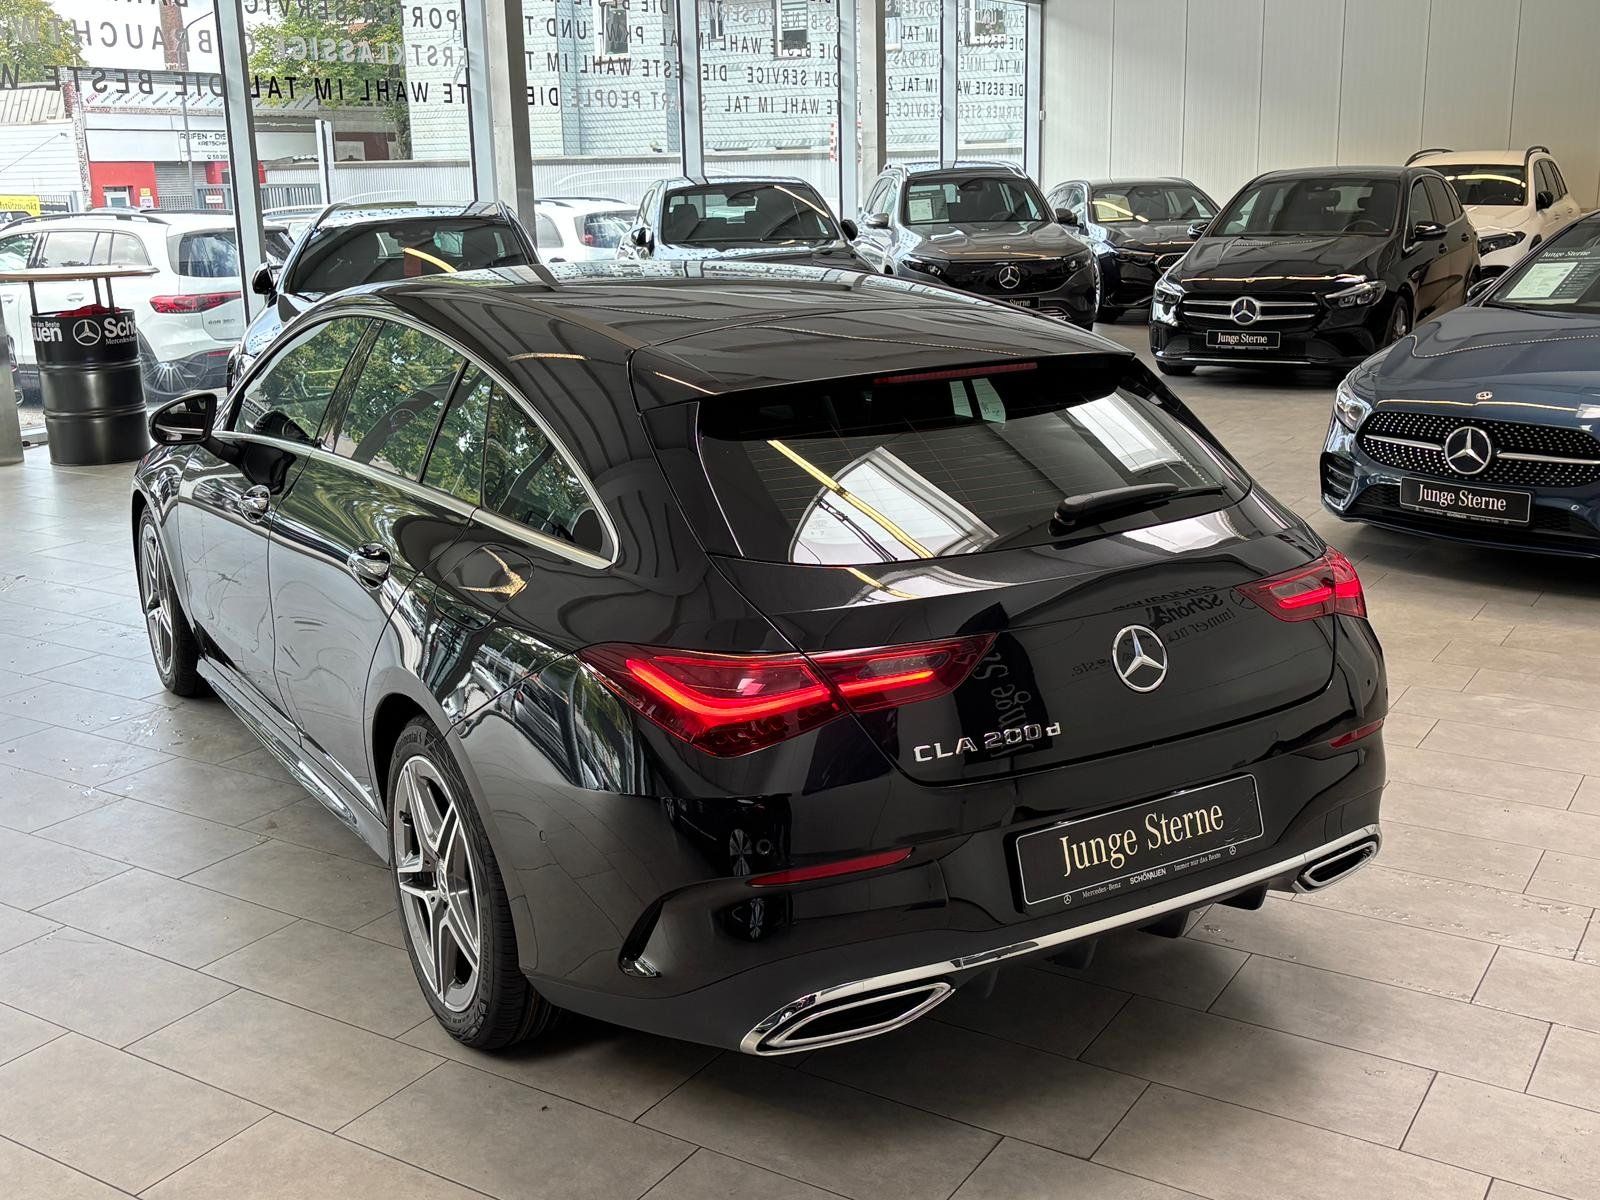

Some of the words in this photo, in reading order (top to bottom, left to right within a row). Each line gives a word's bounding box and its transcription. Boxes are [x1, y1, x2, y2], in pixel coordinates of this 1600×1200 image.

[1216, 332, 1240, 345] Junge
[1240, 332, 1268, 344] Sterne
[1417, 483, 1455, 508] Junge
[1458, 489, 1507, 512] Sterne
[913, 736, 978, 762] CLA
[1059, 828, 1138, 877] Junge
[1144, 804, 1225, 851] Sterne
[1129, 867, 1167, 886] SCHÖNAUEN
